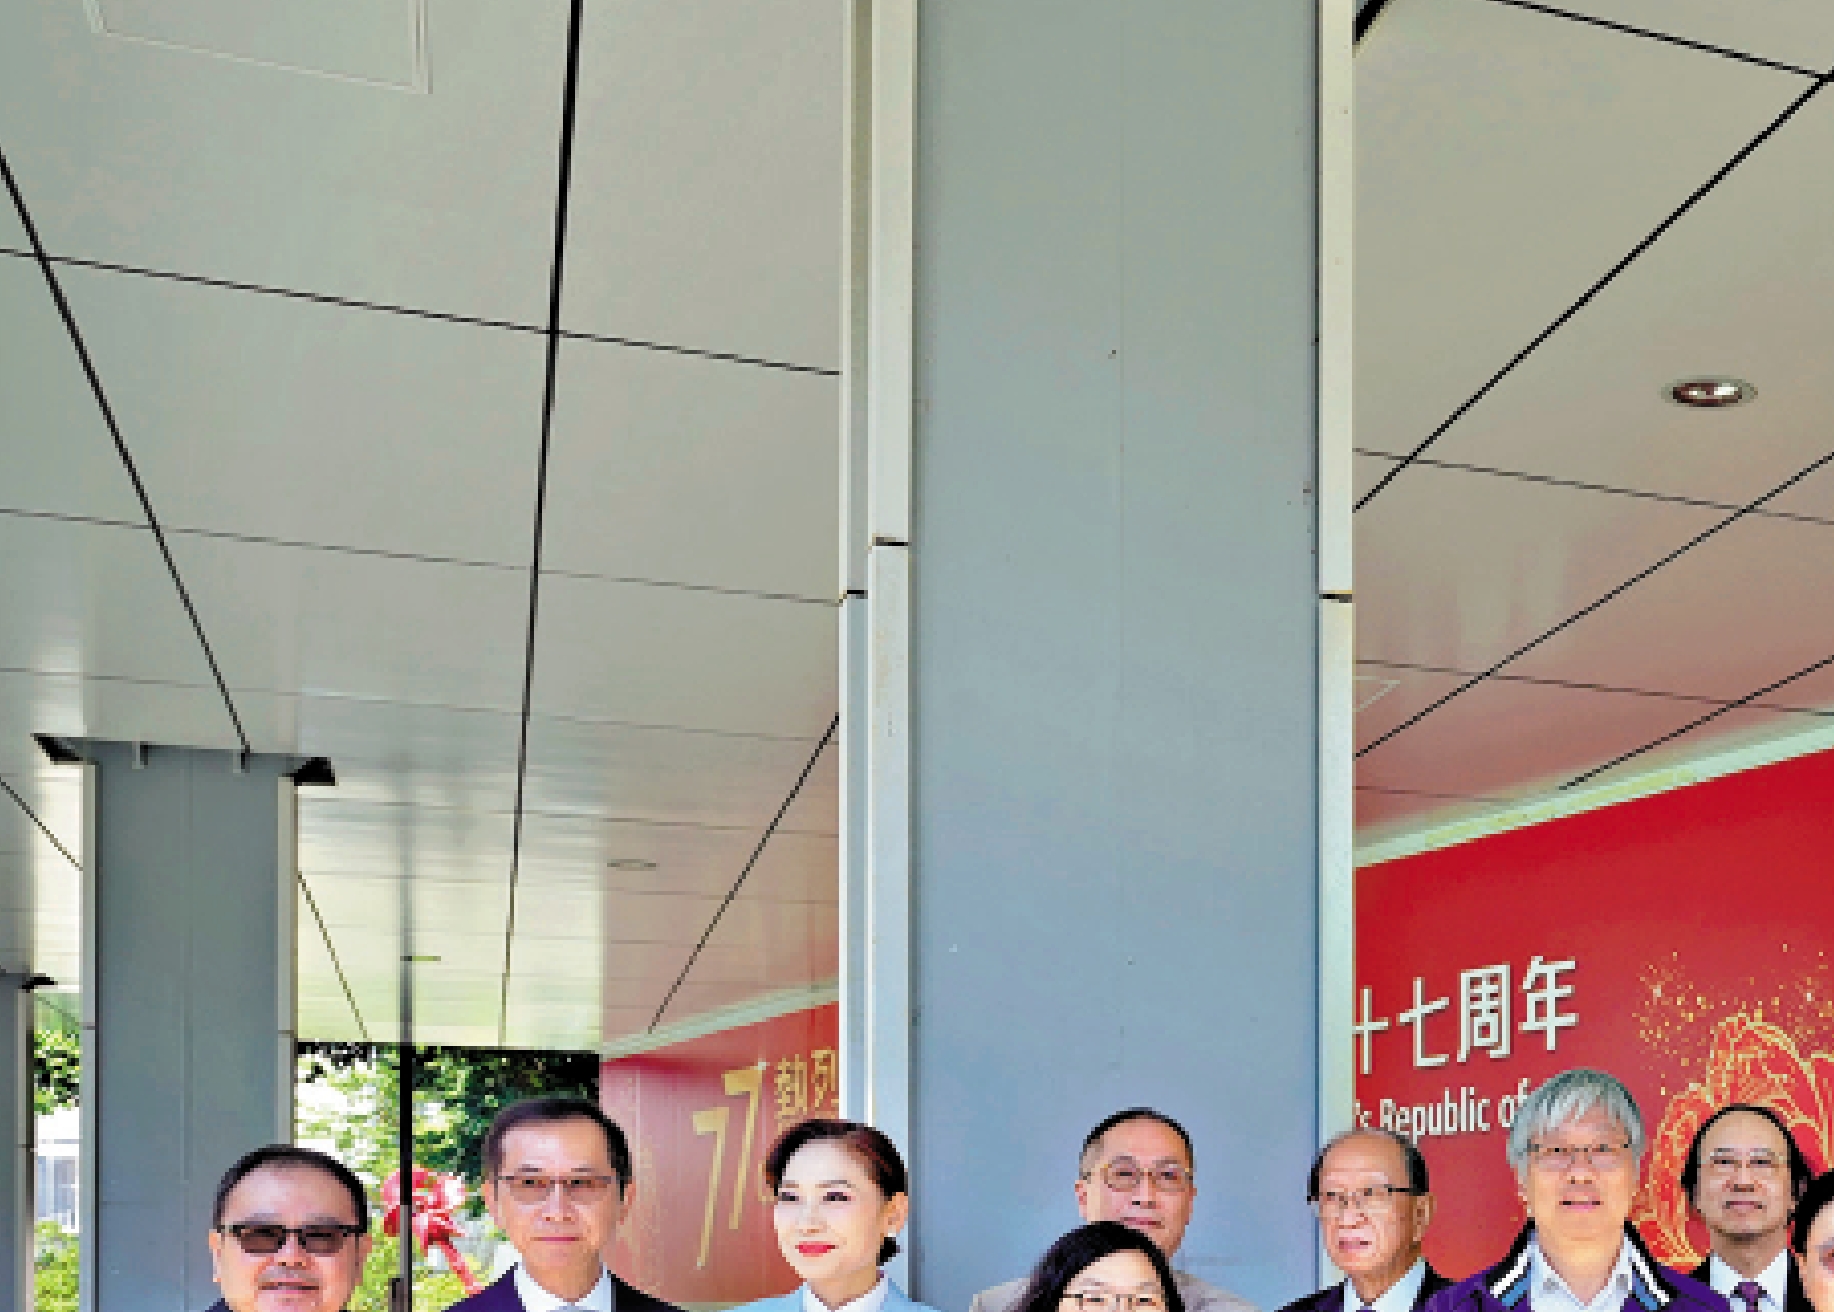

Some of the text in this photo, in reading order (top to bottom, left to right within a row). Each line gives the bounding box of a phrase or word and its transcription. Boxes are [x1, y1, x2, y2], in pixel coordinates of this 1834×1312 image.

[1353, 955, 1580, 1077] 十七周年
[1378, 1086, 1491, 1146] Republic
[1498, 1077, 1531, 1128] of
